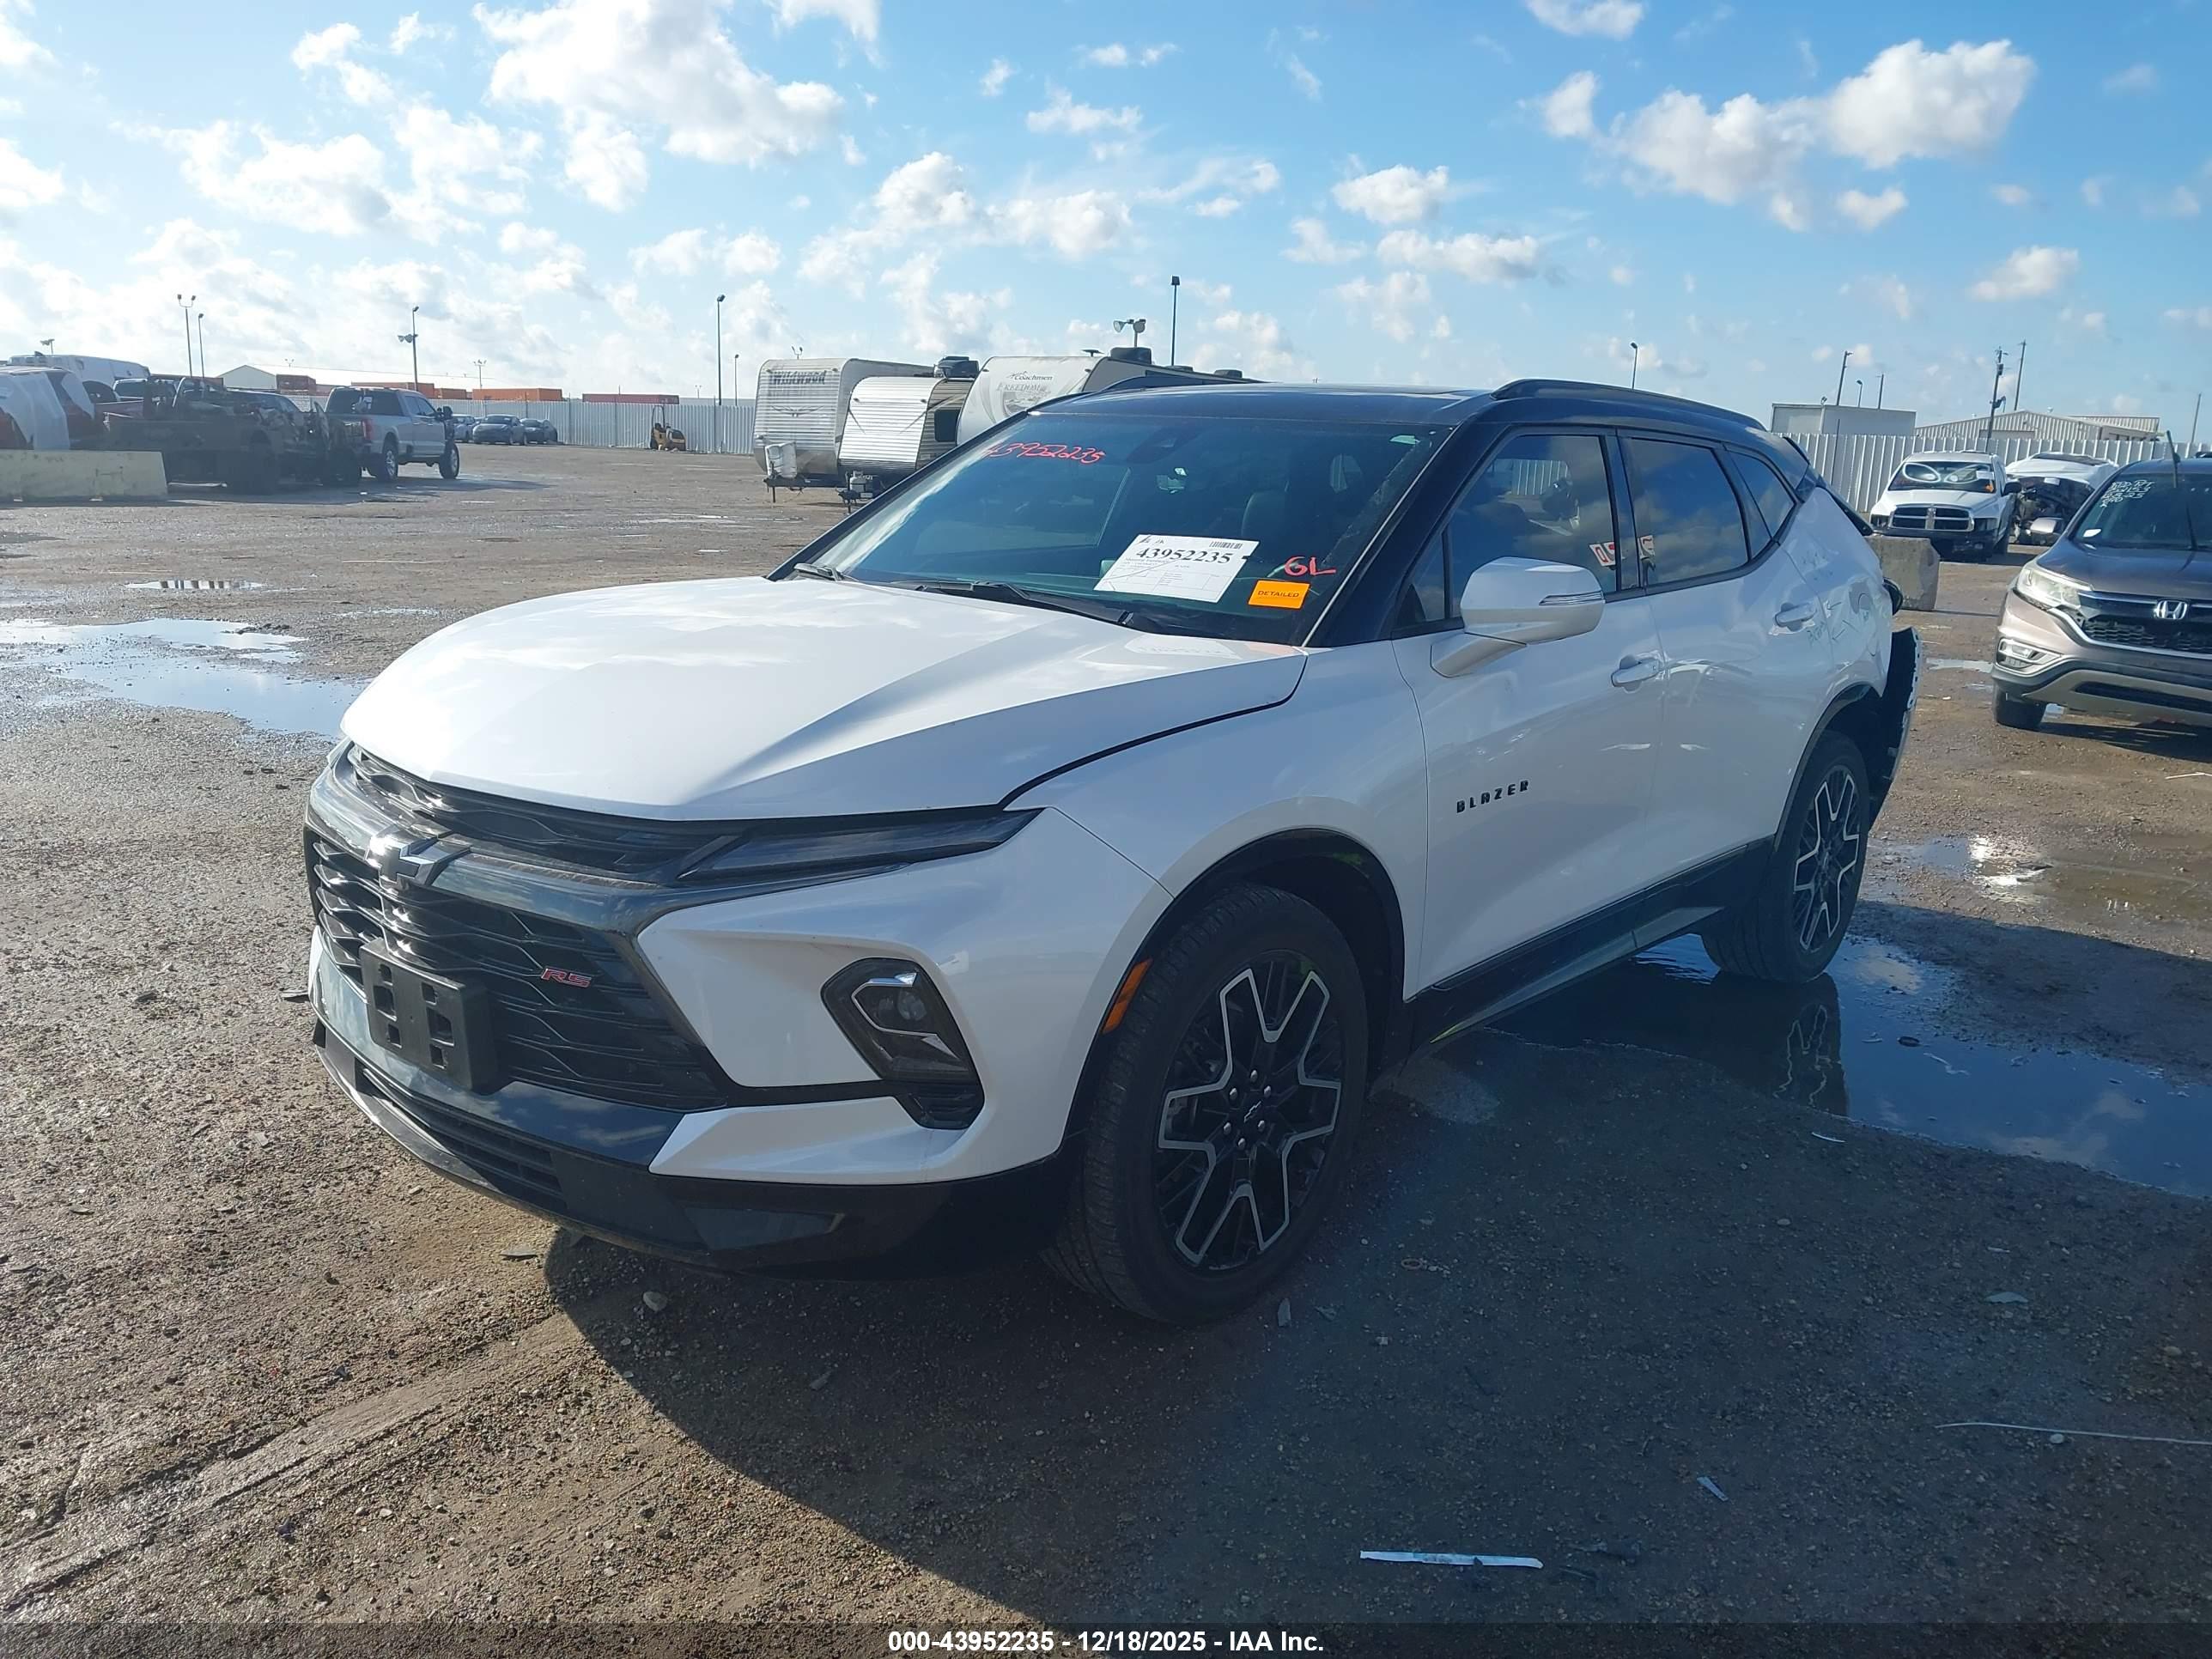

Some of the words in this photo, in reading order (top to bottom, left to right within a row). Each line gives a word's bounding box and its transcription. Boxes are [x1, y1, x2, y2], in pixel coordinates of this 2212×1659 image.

[1136, 547, 1233, 564] 43952235
[1257, 589, 1300, 598] DETAILED
[1456, 780, 1528, 814] BLAZER
[540, 967, 592, 988] RS
